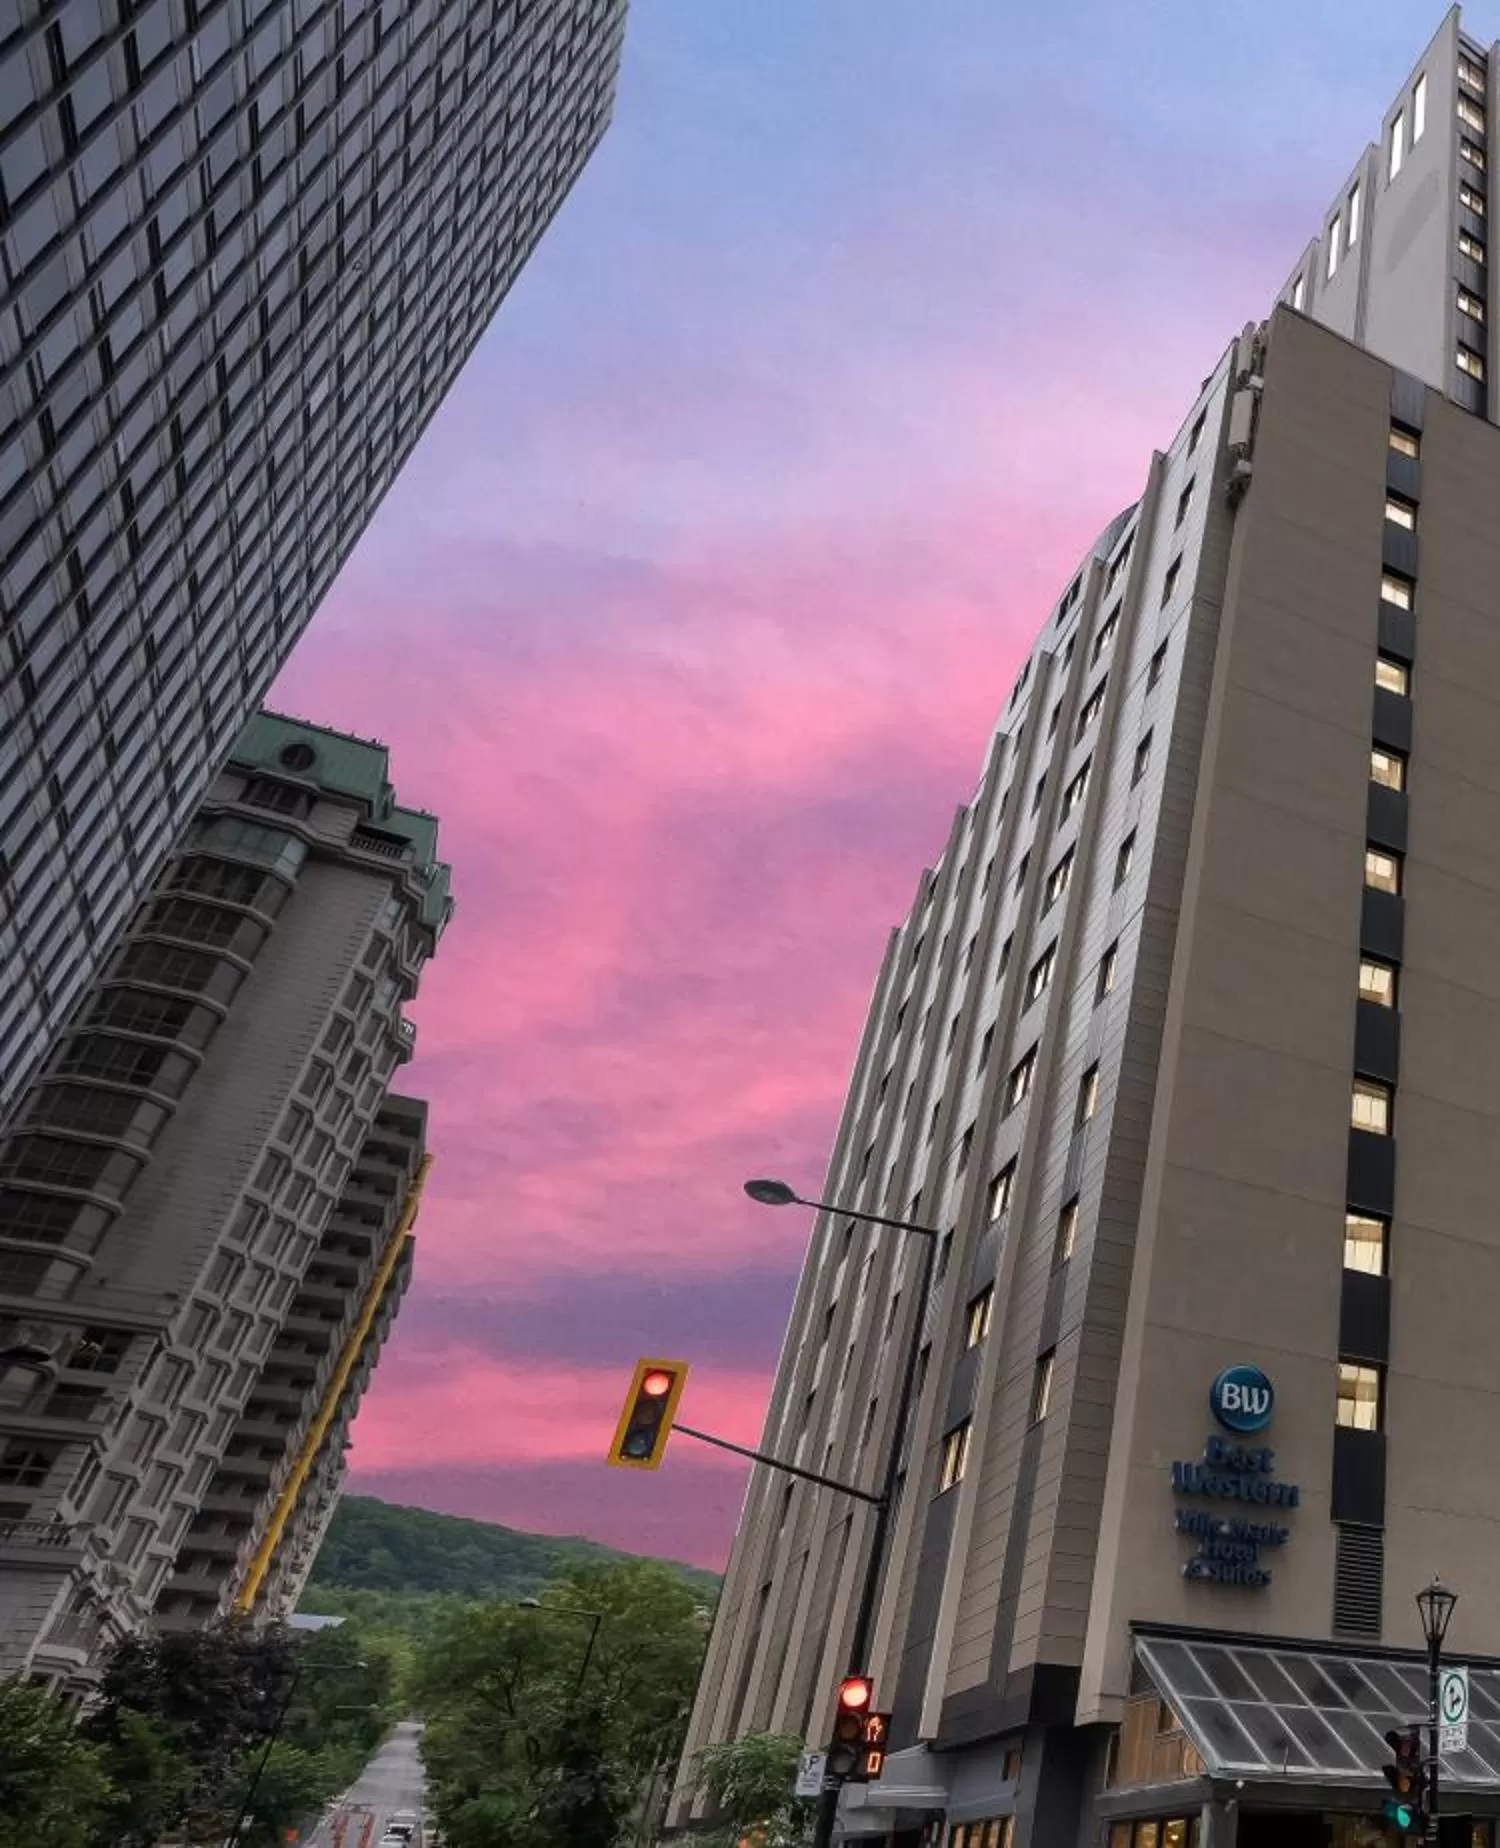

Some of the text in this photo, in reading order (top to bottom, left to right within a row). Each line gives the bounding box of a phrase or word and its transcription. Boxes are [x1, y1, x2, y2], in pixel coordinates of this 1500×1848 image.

[1221, 1383, 1269, 1414] BW
[1205, 1434, 1275, 1473] Best
[1173, 1461, 1299, 1506] Western
